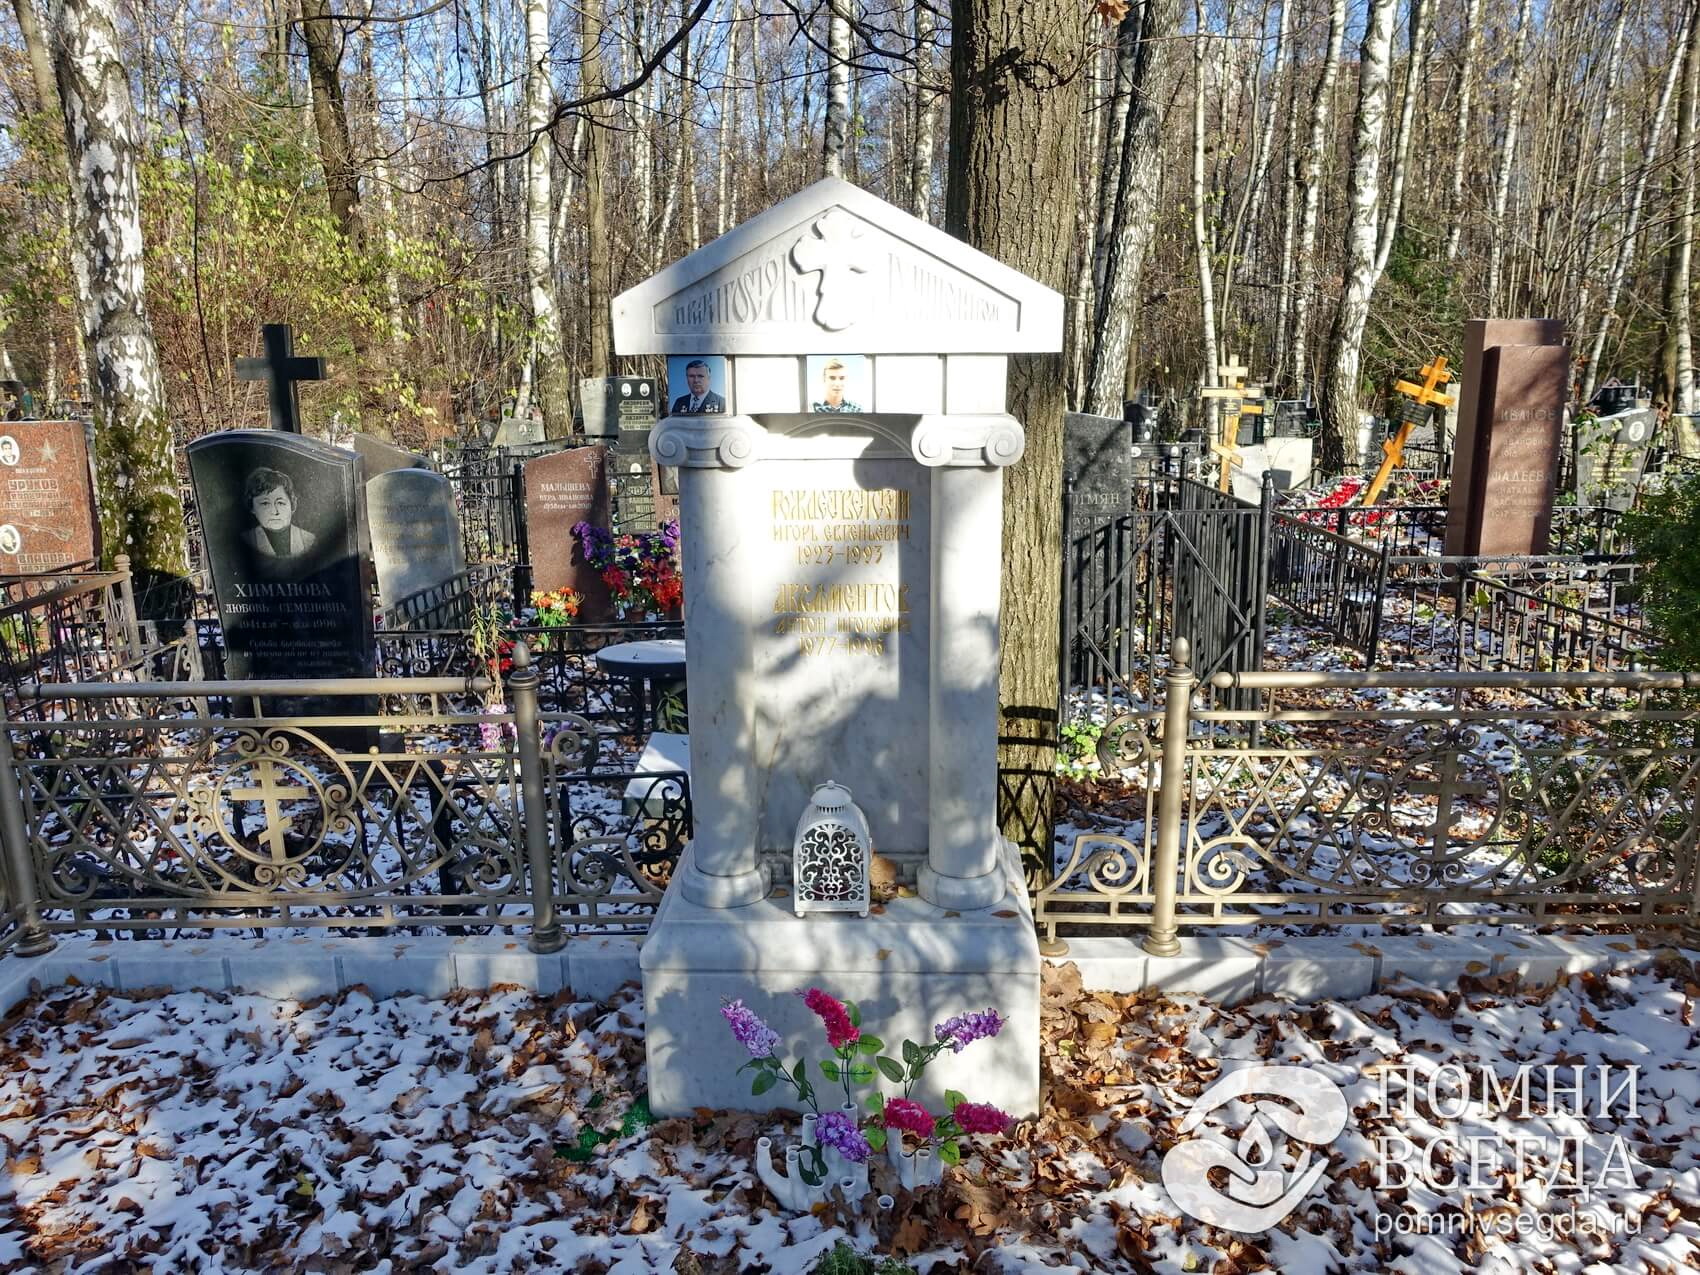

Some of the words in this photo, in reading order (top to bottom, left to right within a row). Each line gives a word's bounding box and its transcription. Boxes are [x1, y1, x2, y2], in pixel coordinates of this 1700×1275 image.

[772, 524, 819, 541] ИГОРЬ
[233, 583, 332, 598] ХИМАНОВА
[224, 602, 270, 614] ЛЮБОВЬ
